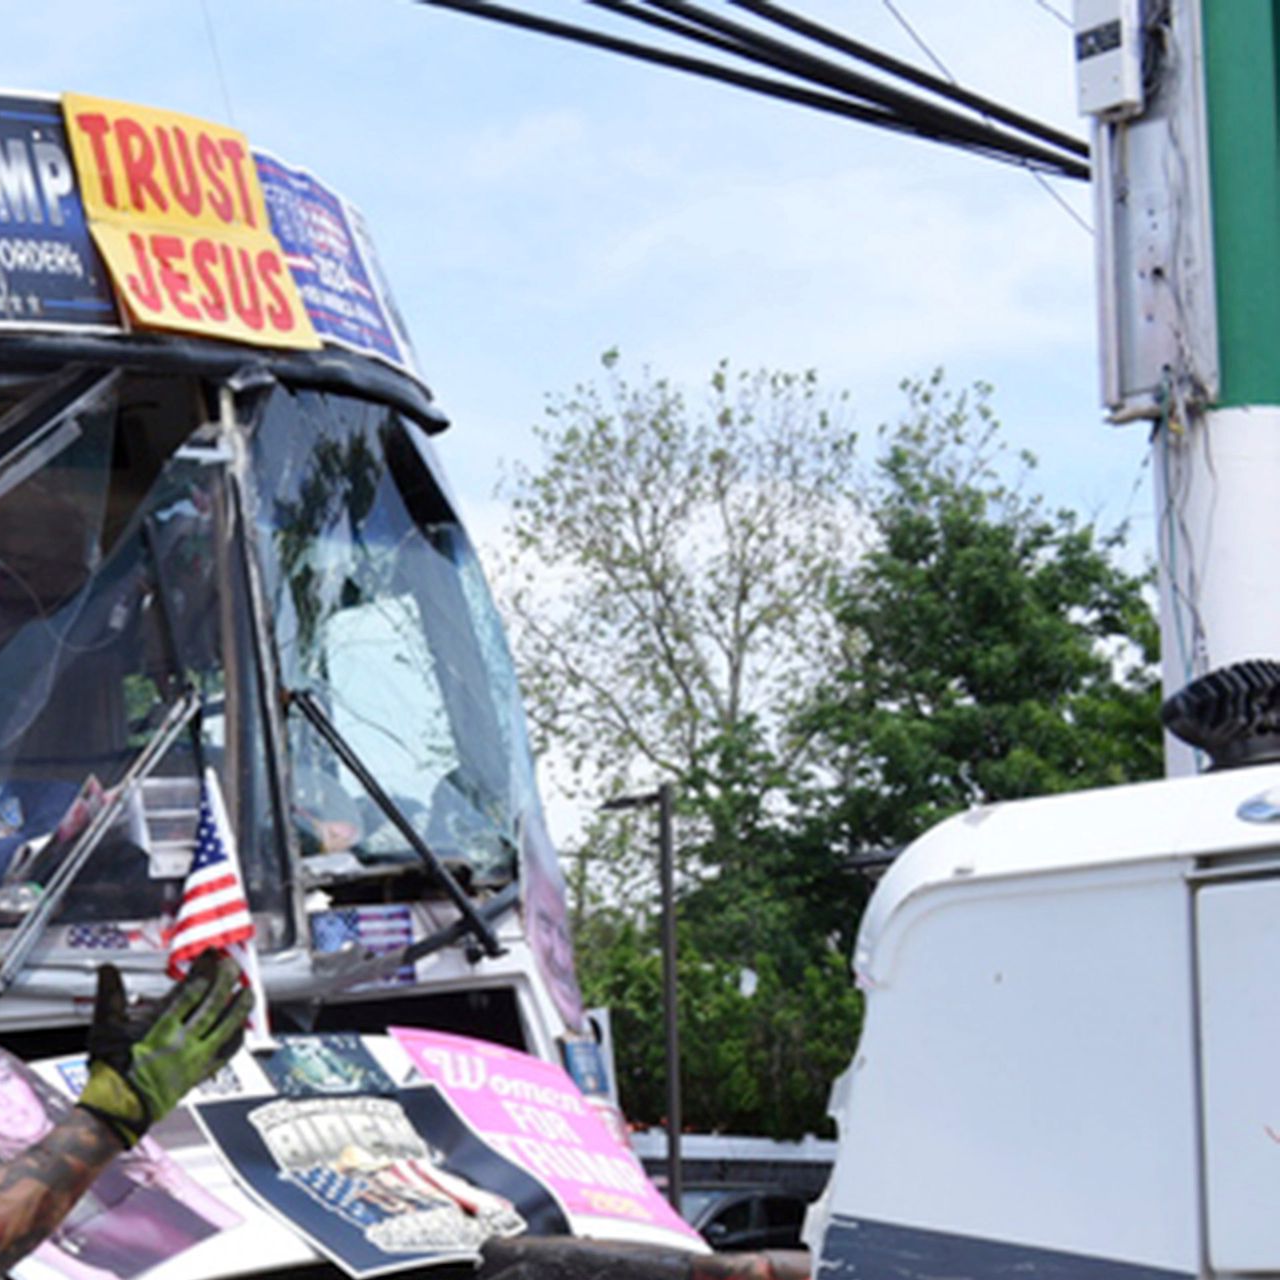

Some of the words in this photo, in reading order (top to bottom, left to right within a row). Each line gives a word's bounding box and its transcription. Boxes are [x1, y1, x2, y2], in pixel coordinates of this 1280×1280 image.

[74, 112, 257, 229] TRUST
[127, 230, 296, 332] JESUS
[423, 1047, 584, 1118] Women
[502, 1100, 582, 1146] FOR
[484, 1132, 647, 1200] TRUMP
